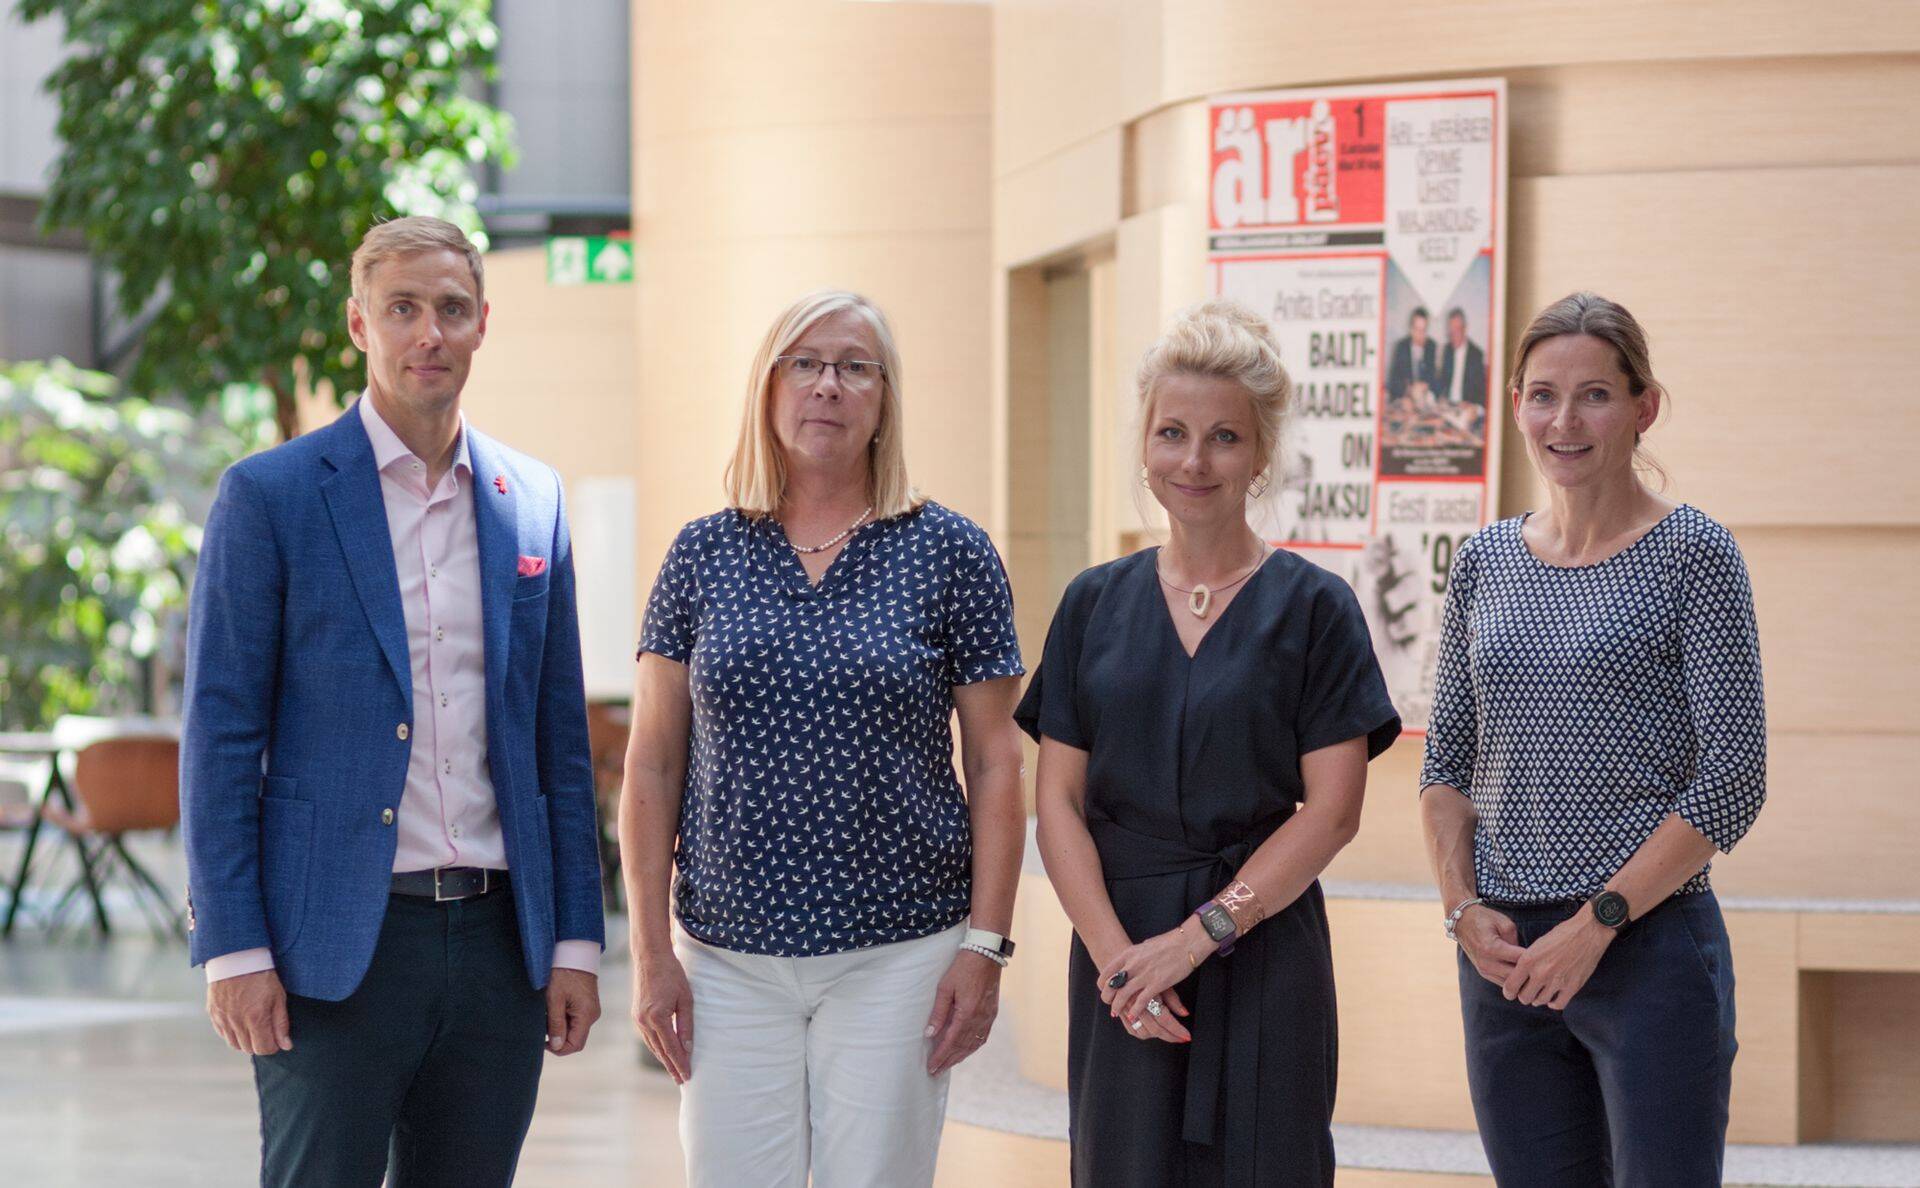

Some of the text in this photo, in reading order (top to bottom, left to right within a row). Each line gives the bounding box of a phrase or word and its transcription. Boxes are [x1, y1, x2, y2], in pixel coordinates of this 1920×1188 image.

[1353, 103, 1365, 139] 1
[1274, 289, 1314, 320] Anita
[1309, 331, 1375, 368] BALTI-
[1341, 432, 1372, 468] ON
[1298, 483, 1371, 520] JAKSU
